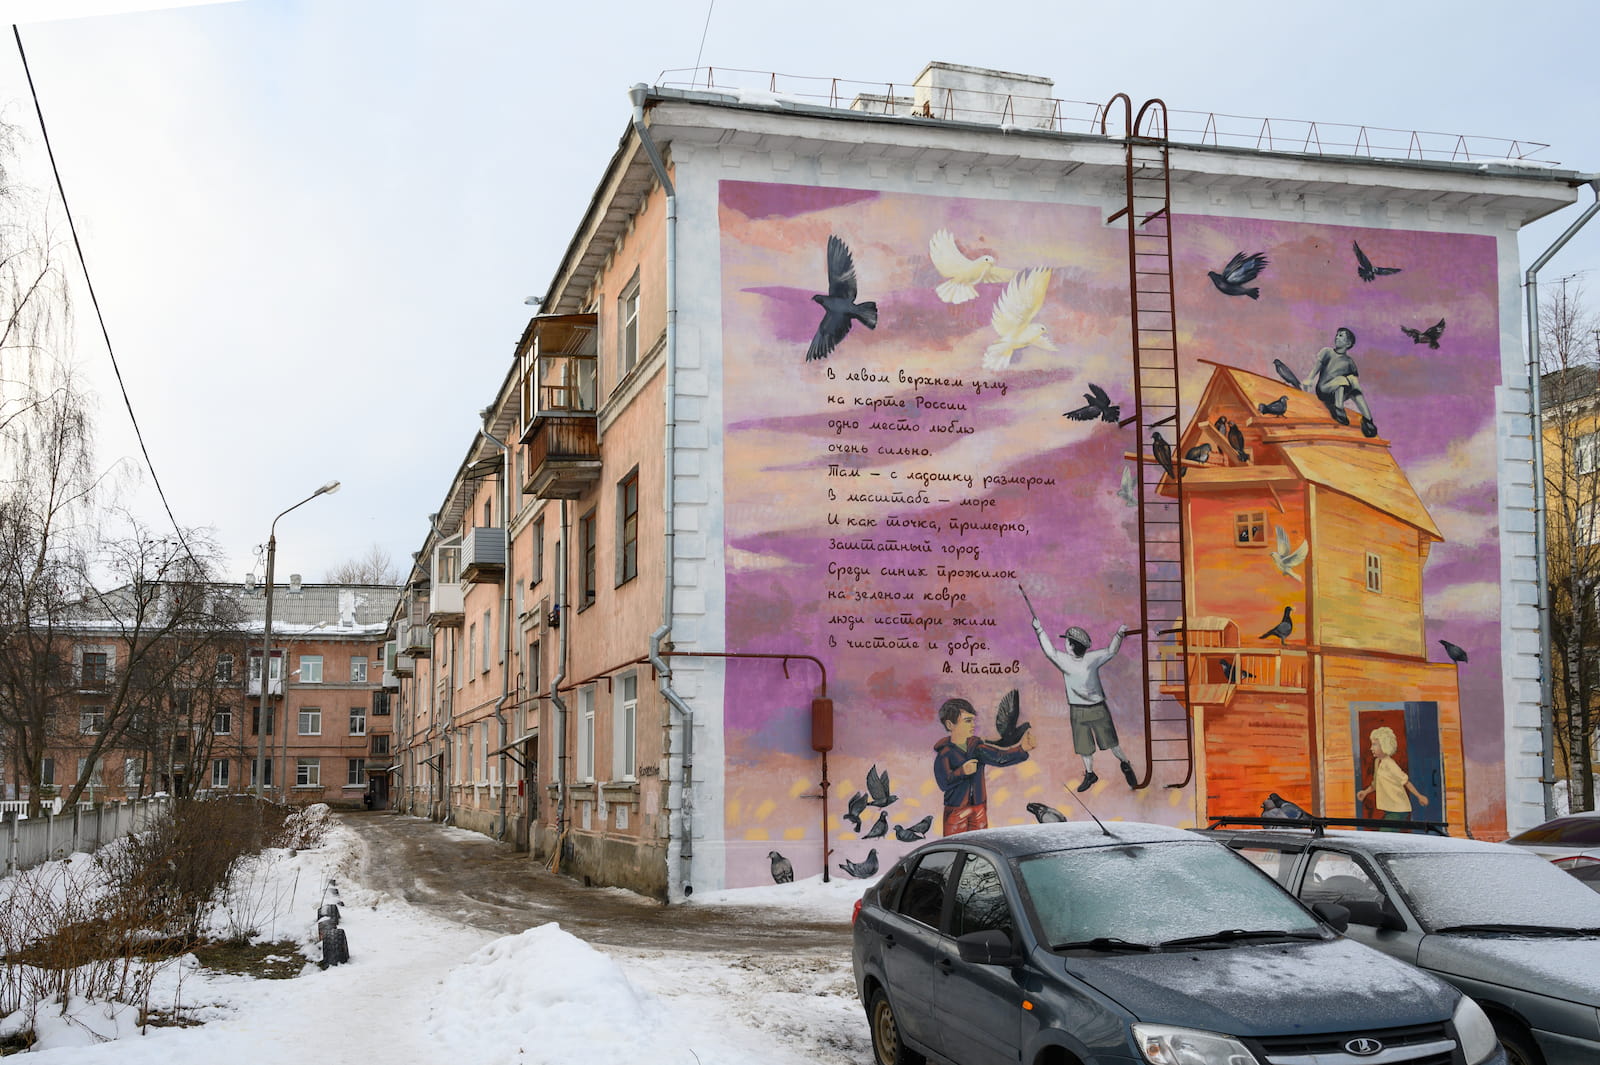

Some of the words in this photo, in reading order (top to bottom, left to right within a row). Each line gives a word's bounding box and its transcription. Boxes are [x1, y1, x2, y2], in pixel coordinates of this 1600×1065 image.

[846, 368, 890, 383] левом
[899, 369, 964, 392] верхнем
[972, 380, 1008, 397] углу
[828, 395, 845, 405] на
[854, 396, 906, 412] карте
[915, 396, 967, 411] России
[828, 420, 859, 435] одно
[869, 419, 920, 432] место
[929, 420, 975, 435] люблю
[828, 443, 868, 454] очень
[878, 446, 933, 457] сильно.
[828, 464, 861, 477] Там
[907, 473, 973, 488] ладошку
[983, 475, 1056, 489] размером
[847, 490, 931, 505] масштабе
[960, 497, 997, 513] море
[828, 513, 840, 526] И
[847, 518, 878, 528] как
[886, 516, 942, 533] точка,
[950, 518, 1030, 536] примерно,
[828, 538, 933, 553] Заштатный
[828, 561, 870, 582] Среди
[881, 567, 928, 577] синих
[937, 565, 1017, 583] прожилок
[828, 590, 847, 600] на
[855, 591, 915, 601] зеленом
[923, 587, 967, 608] ковре
[828, 616, 864, 631] люди
[874, 613, 943, 631] исстари
[952, 618, 998, 627] жили
[847, 636, 920, 649] чистоте
[928, 642, 939, 650] и
[948, 635, 990, 656] добре.
[961, 660, 1020, 675] Ипатов
